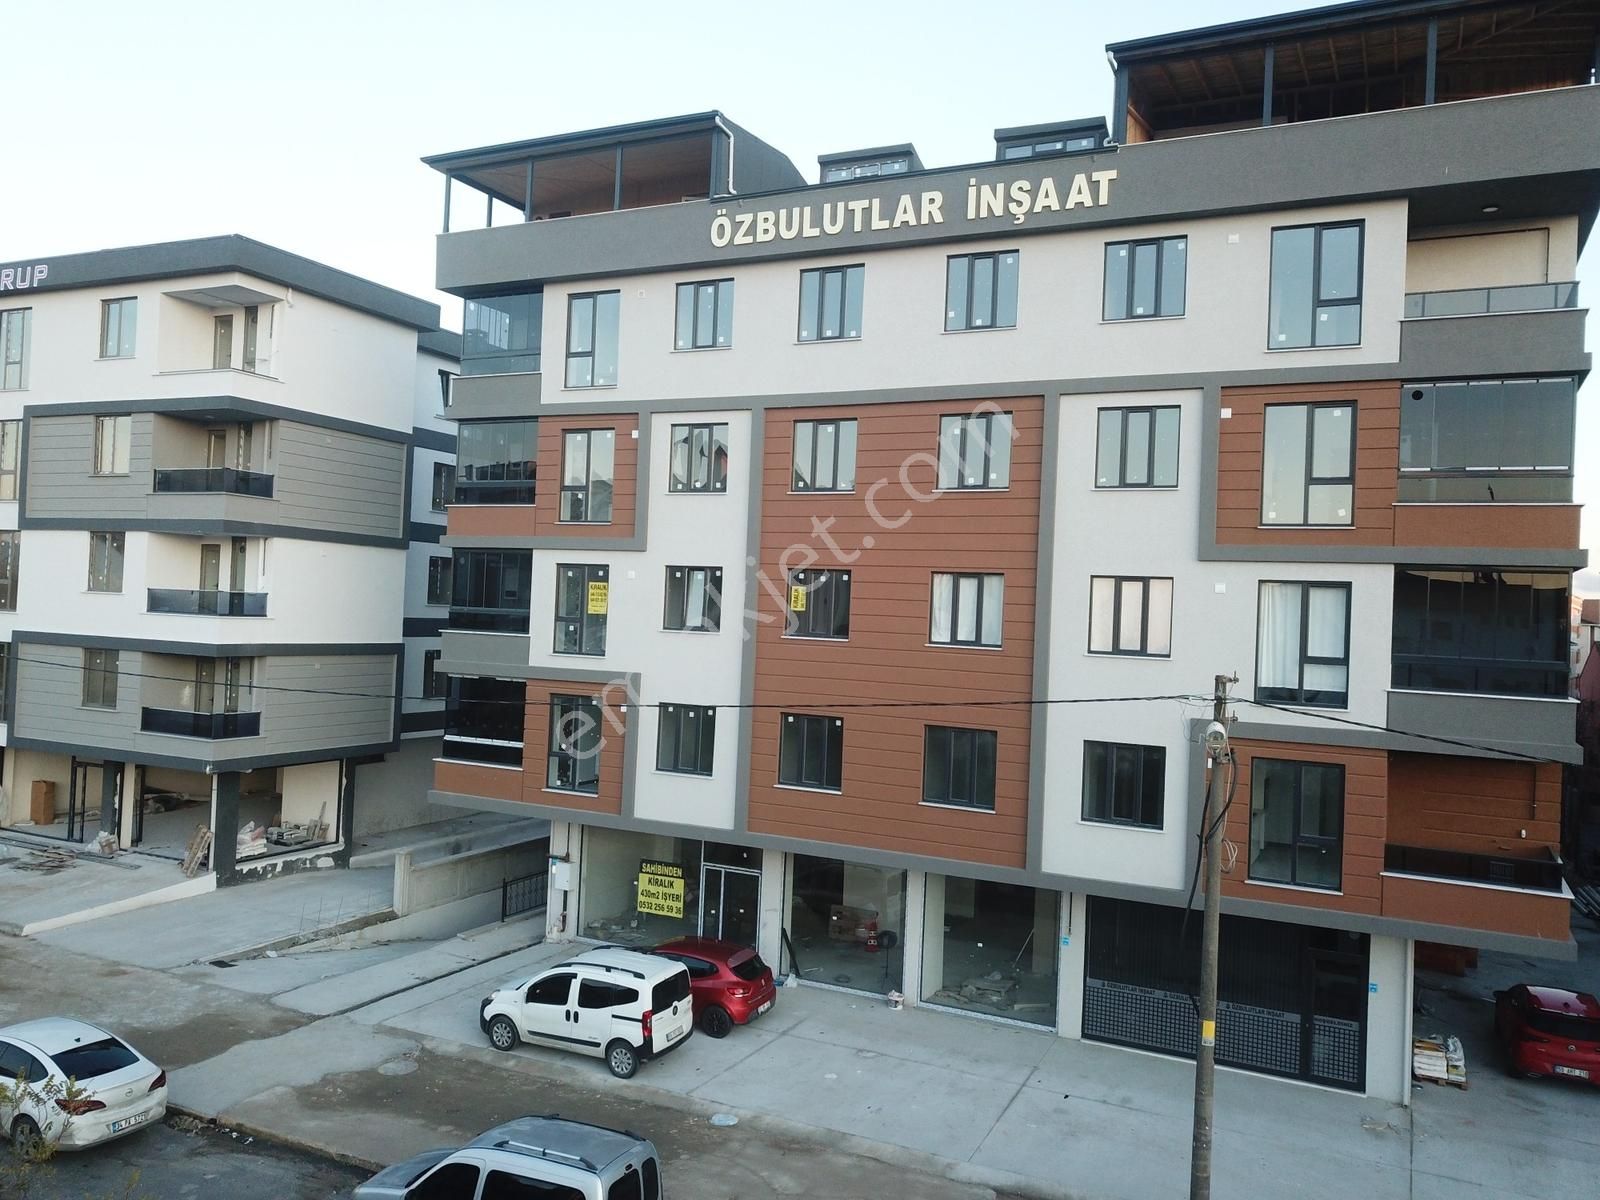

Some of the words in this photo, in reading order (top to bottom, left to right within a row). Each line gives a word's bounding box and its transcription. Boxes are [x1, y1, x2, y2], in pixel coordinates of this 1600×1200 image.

[710, 190, 944, 248] ÖZBULUTLAR
[966, 169, 1118, 224] İNŞAAT
[0, 264, 49, 291] RUP
[641, 862, 682, 877] SAHİBİNDEN
[647, 876, 675, 889] KİRALIK
[661, 890, 682, 903] İŞYERİ
[638, 900, 653, 911] 0532
